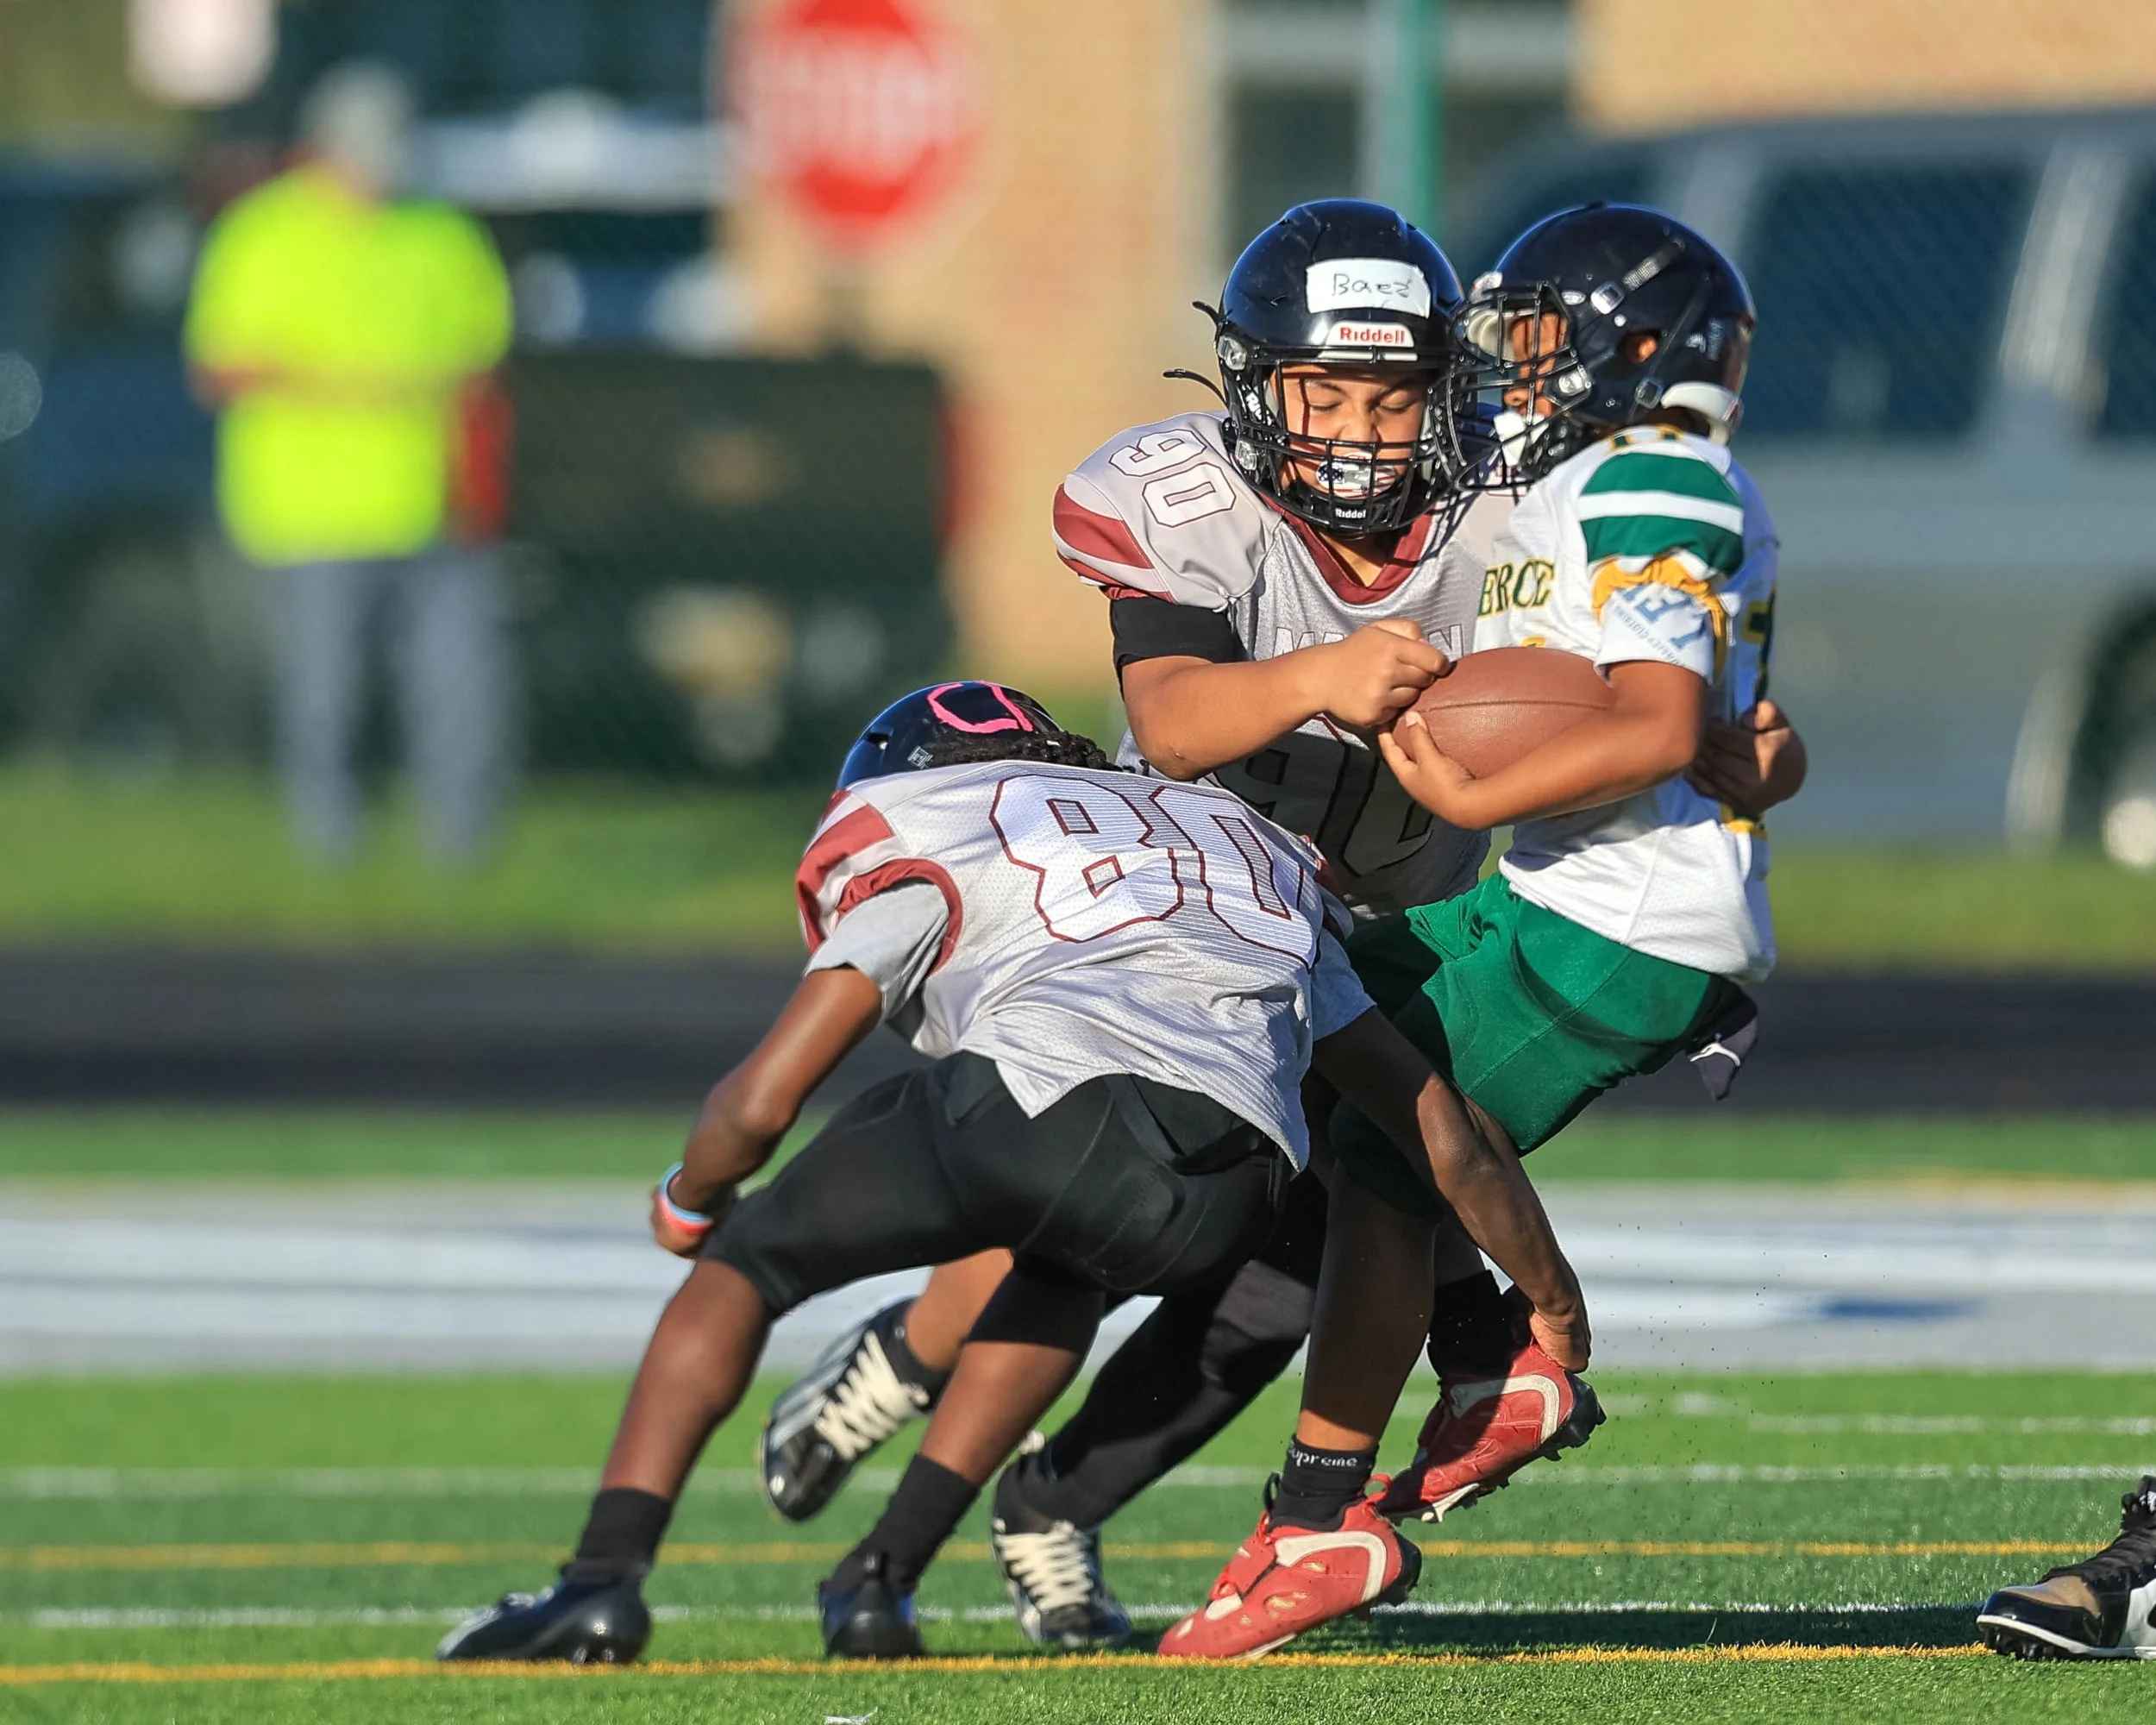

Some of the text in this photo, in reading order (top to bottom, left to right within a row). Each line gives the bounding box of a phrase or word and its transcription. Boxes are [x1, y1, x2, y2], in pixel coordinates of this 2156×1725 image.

[1339, 327, 1406, 344] Riddell
[1109, 429, 1237, 528] 90
[1335, 508, 1367, 518] Riddel
[989, 774, 1319, 975] 80
